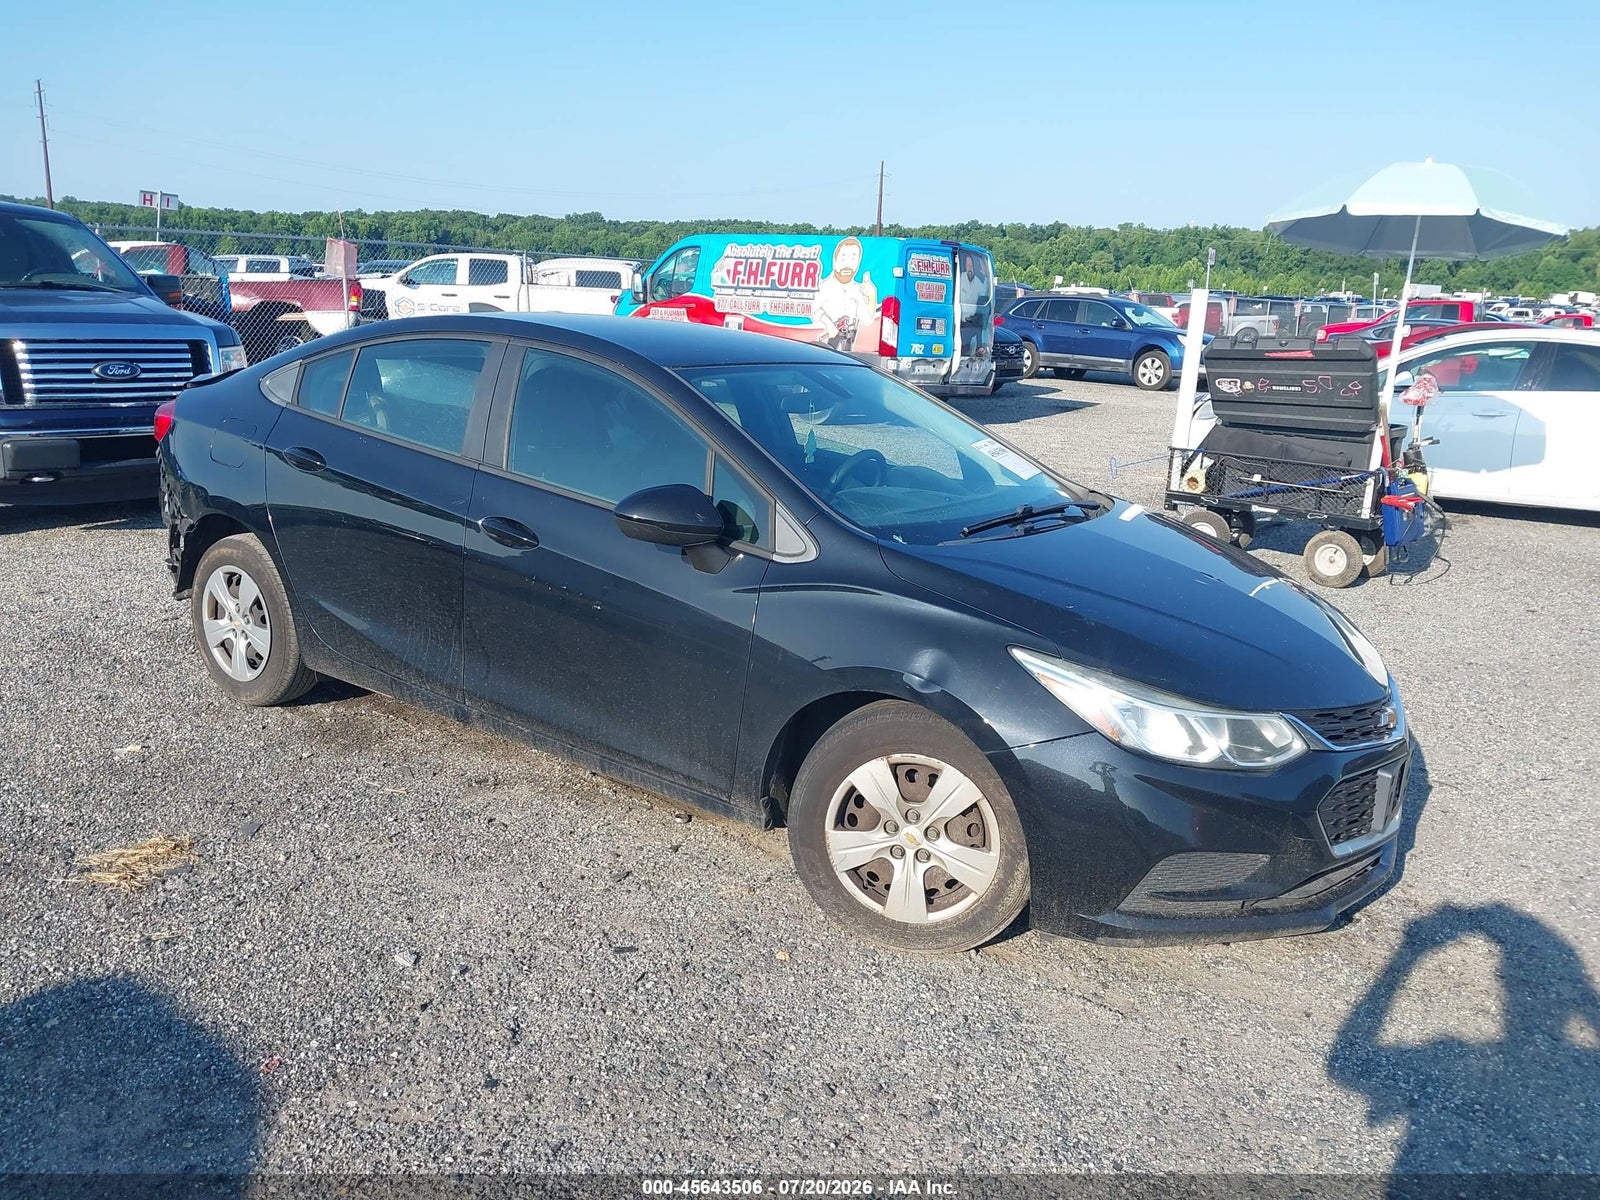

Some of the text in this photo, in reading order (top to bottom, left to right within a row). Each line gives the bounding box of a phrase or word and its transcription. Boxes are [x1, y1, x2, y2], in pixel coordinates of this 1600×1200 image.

[143, 193, 153, 206] H
[166, 197, 170, 208] I
[725, 245, 820, 259] Absolutely the Best!
[732, 260, 819, 287] F.H.FURR
[910, 343, 925, 355] 762
[107, 364, 132, 375] Ford
